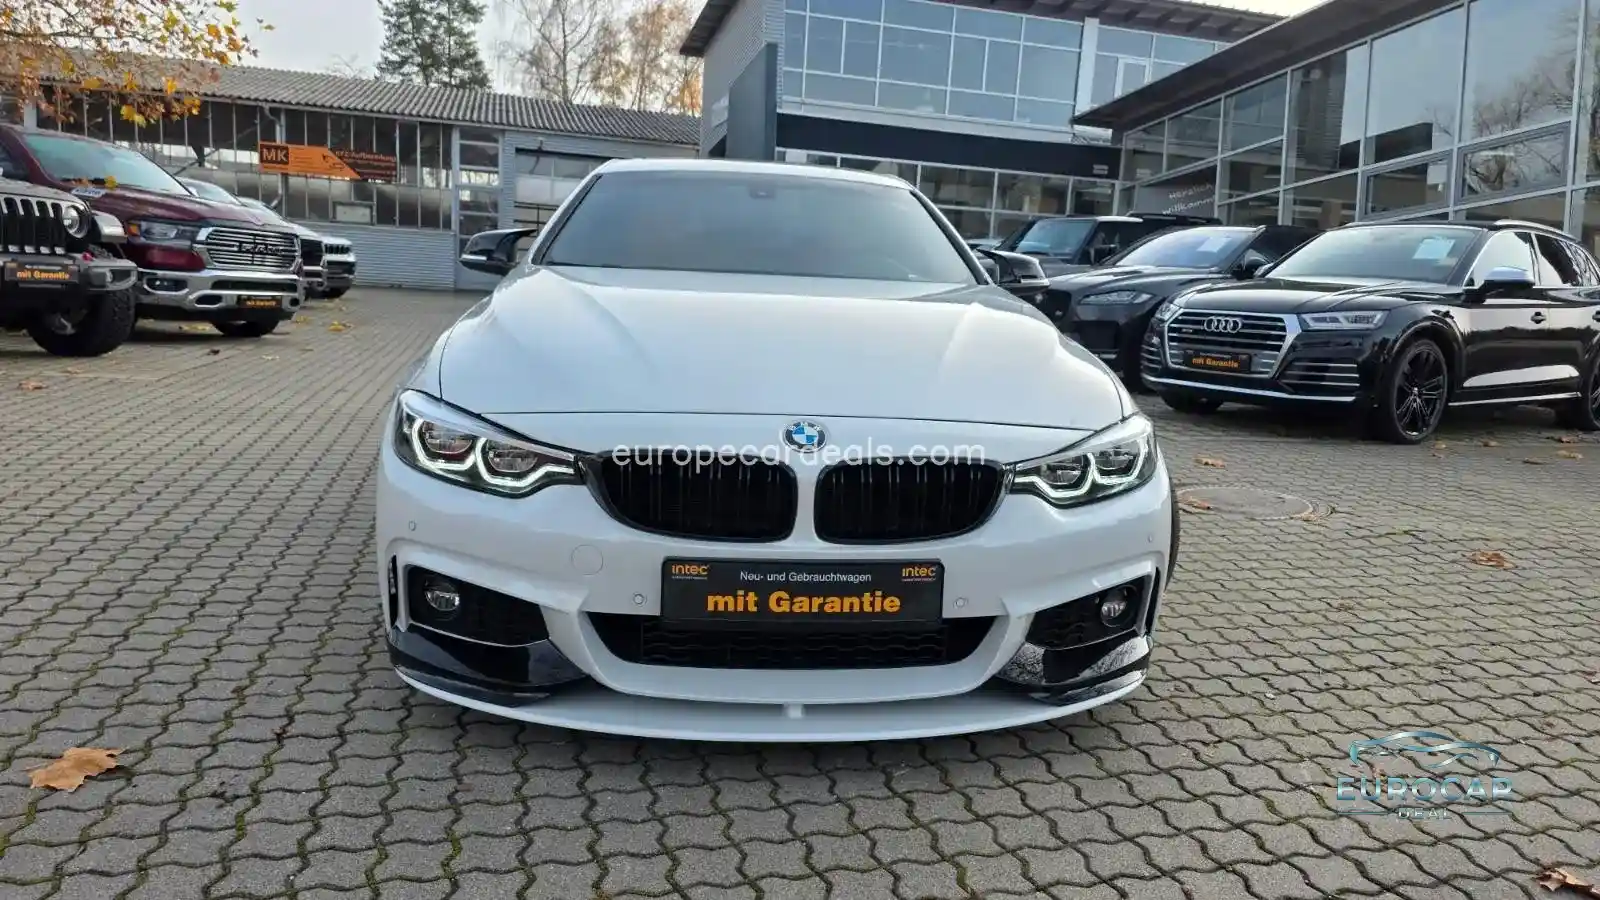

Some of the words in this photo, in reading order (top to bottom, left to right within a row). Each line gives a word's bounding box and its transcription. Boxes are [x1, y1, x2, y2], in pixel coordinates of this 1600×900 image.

[263, 148, 288, 162] MK
[1162, 196, 1216, 215] willkomm
[33, 269, 70, 280] Garantie
[671, 564, 709, 575] intec
[902, 565, 937, 577] intec
[740, 571, 764, 581] Neu-
[767, 571, 786, 581] und
[788, 572, 872, 583] Gebrauchtwagen
[707, 590, 758, 612] mit
[769, 591, 901, 613] Garantie
